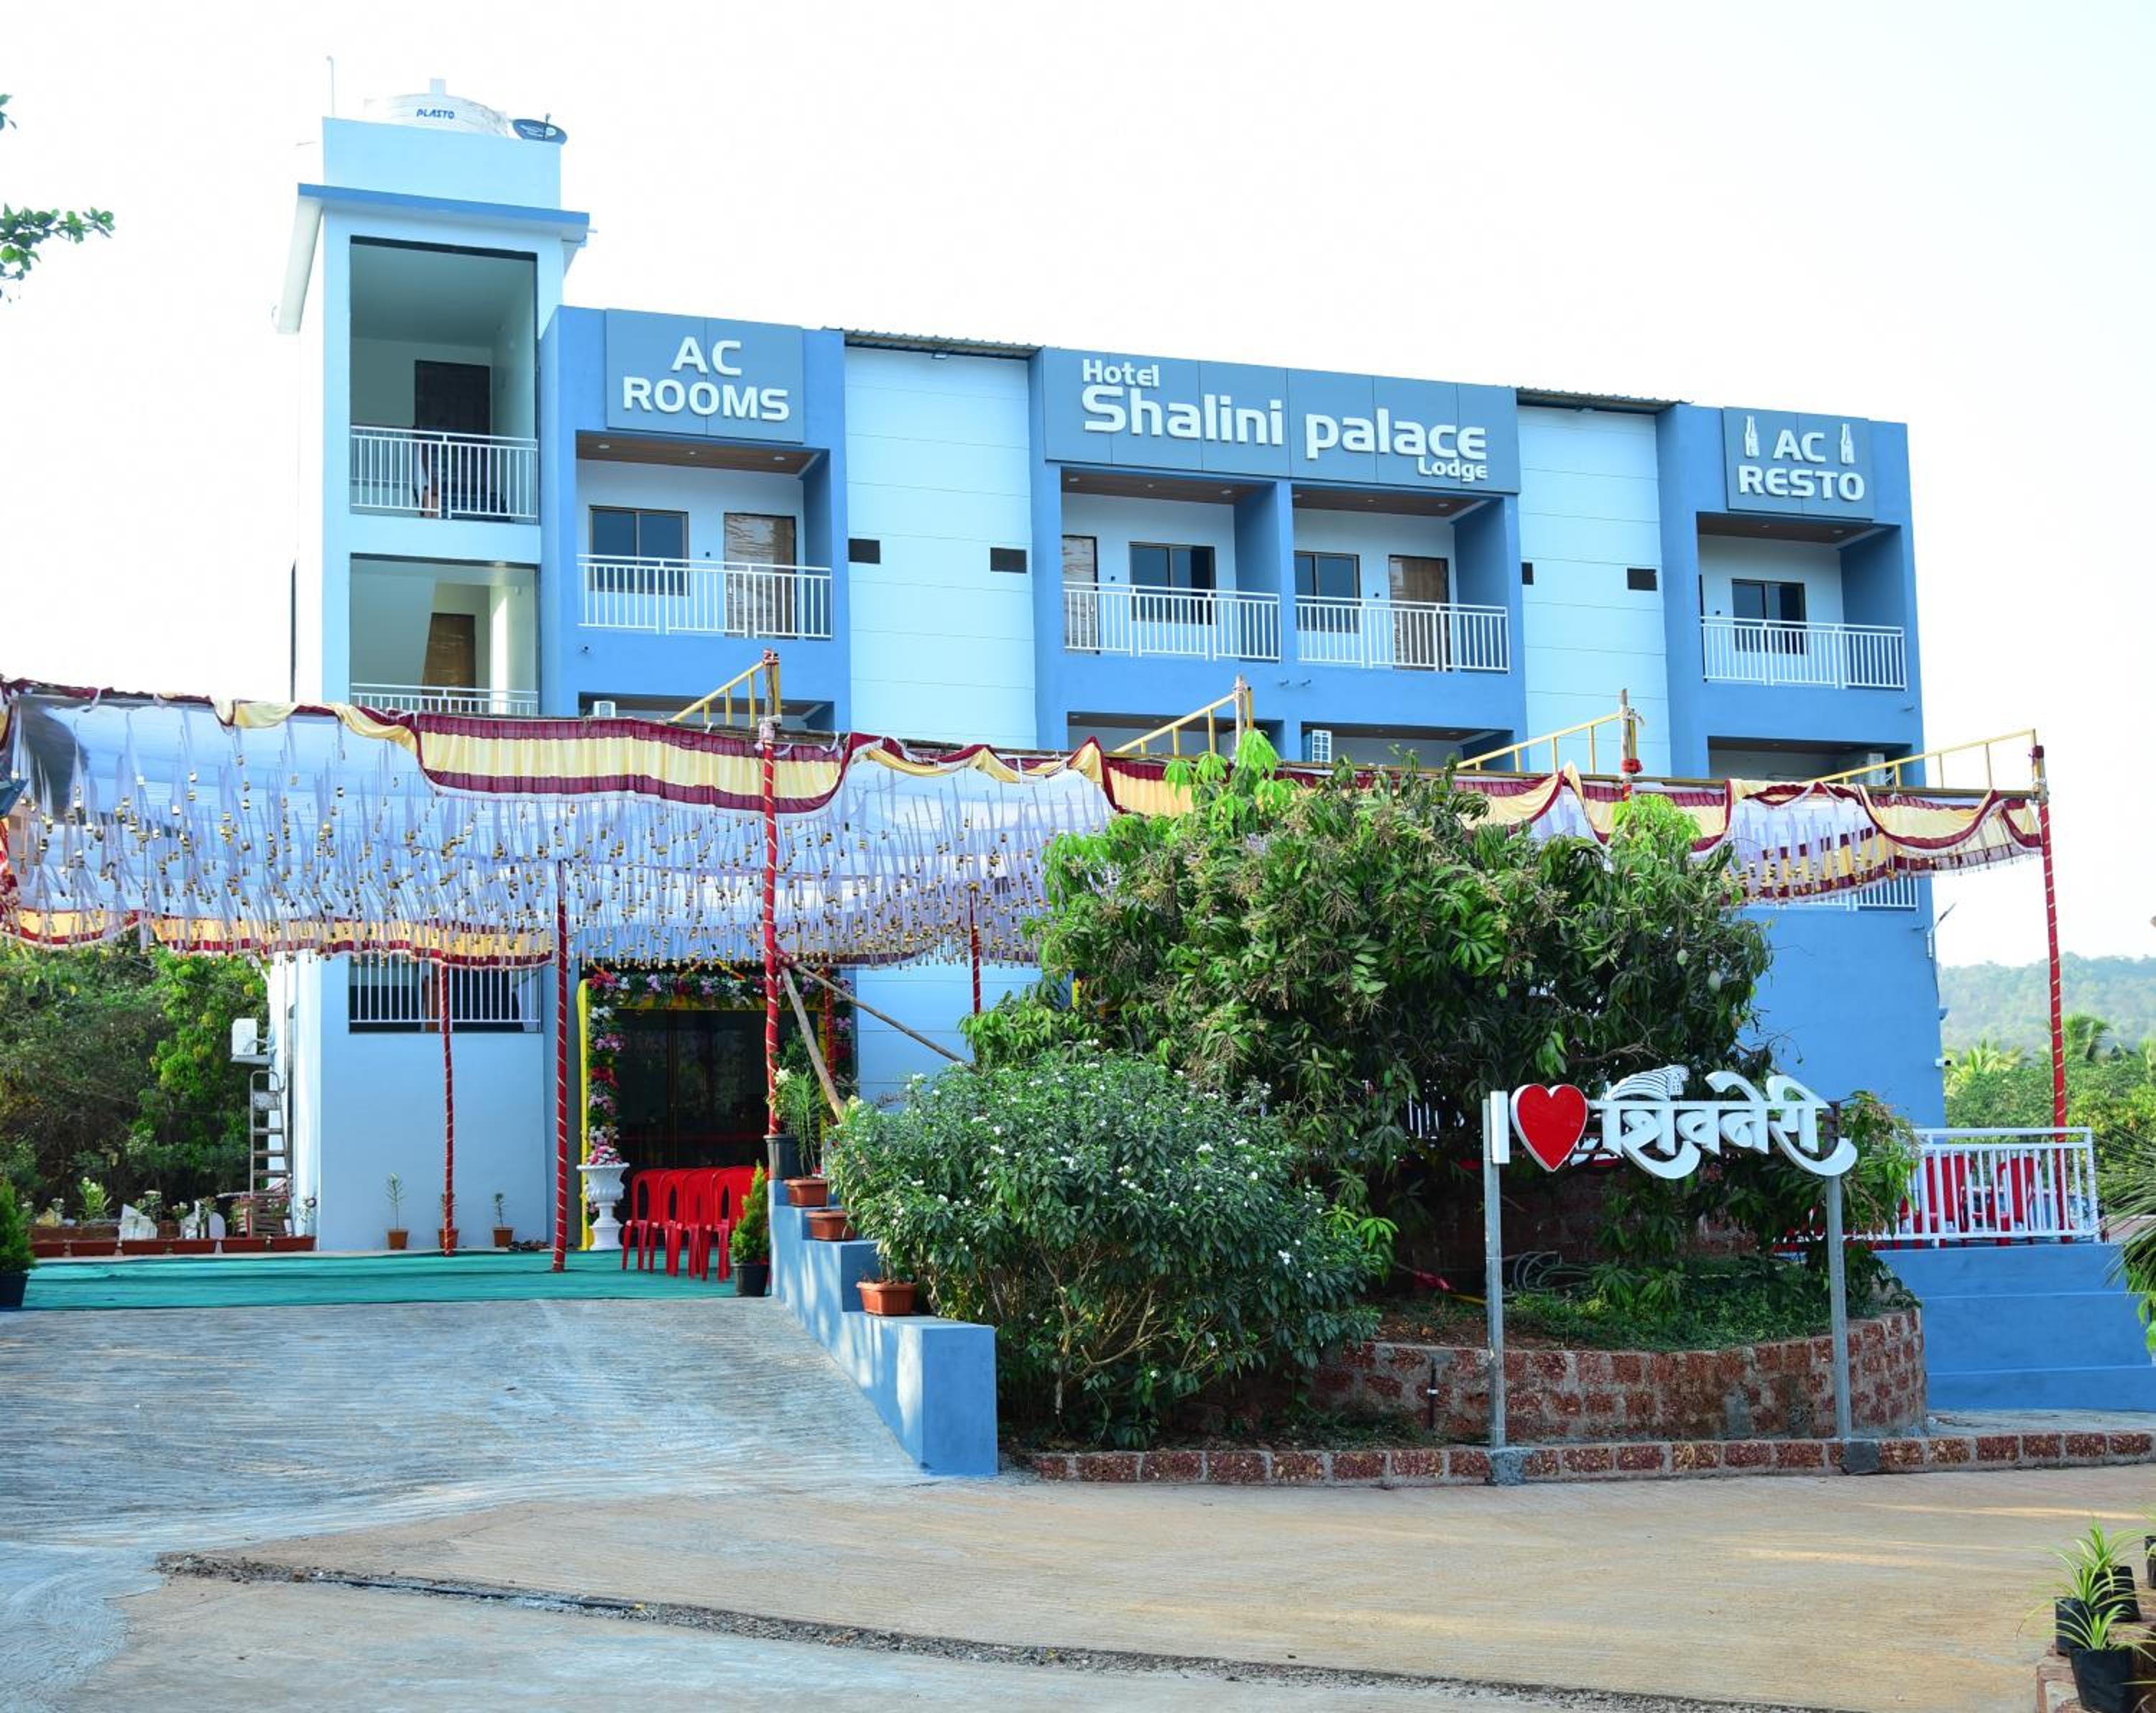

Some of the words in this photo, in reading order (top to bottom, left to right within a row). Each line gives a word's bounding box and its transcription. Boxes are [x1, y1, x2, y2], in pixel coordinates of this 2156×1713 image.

[416, 108, 455, 119] PLASTO
[671, 336, 742, 376] AC
[1082, 359, 1159, 387] Hotel
[622, 376, 790, 421] ROOMS
[1082, 384, 1284, 445] Shalini
[1305, 408, 1486, 460] palace
[1772, 429, 1826, 463] AC
[1417, 456, 1488, 483] Lodge
[1738, 464, 1865, 502] RESTO
[1491, 1091, 1510, 1164] I
[1588, 1065, 1858, 1179] शिवनेरी
